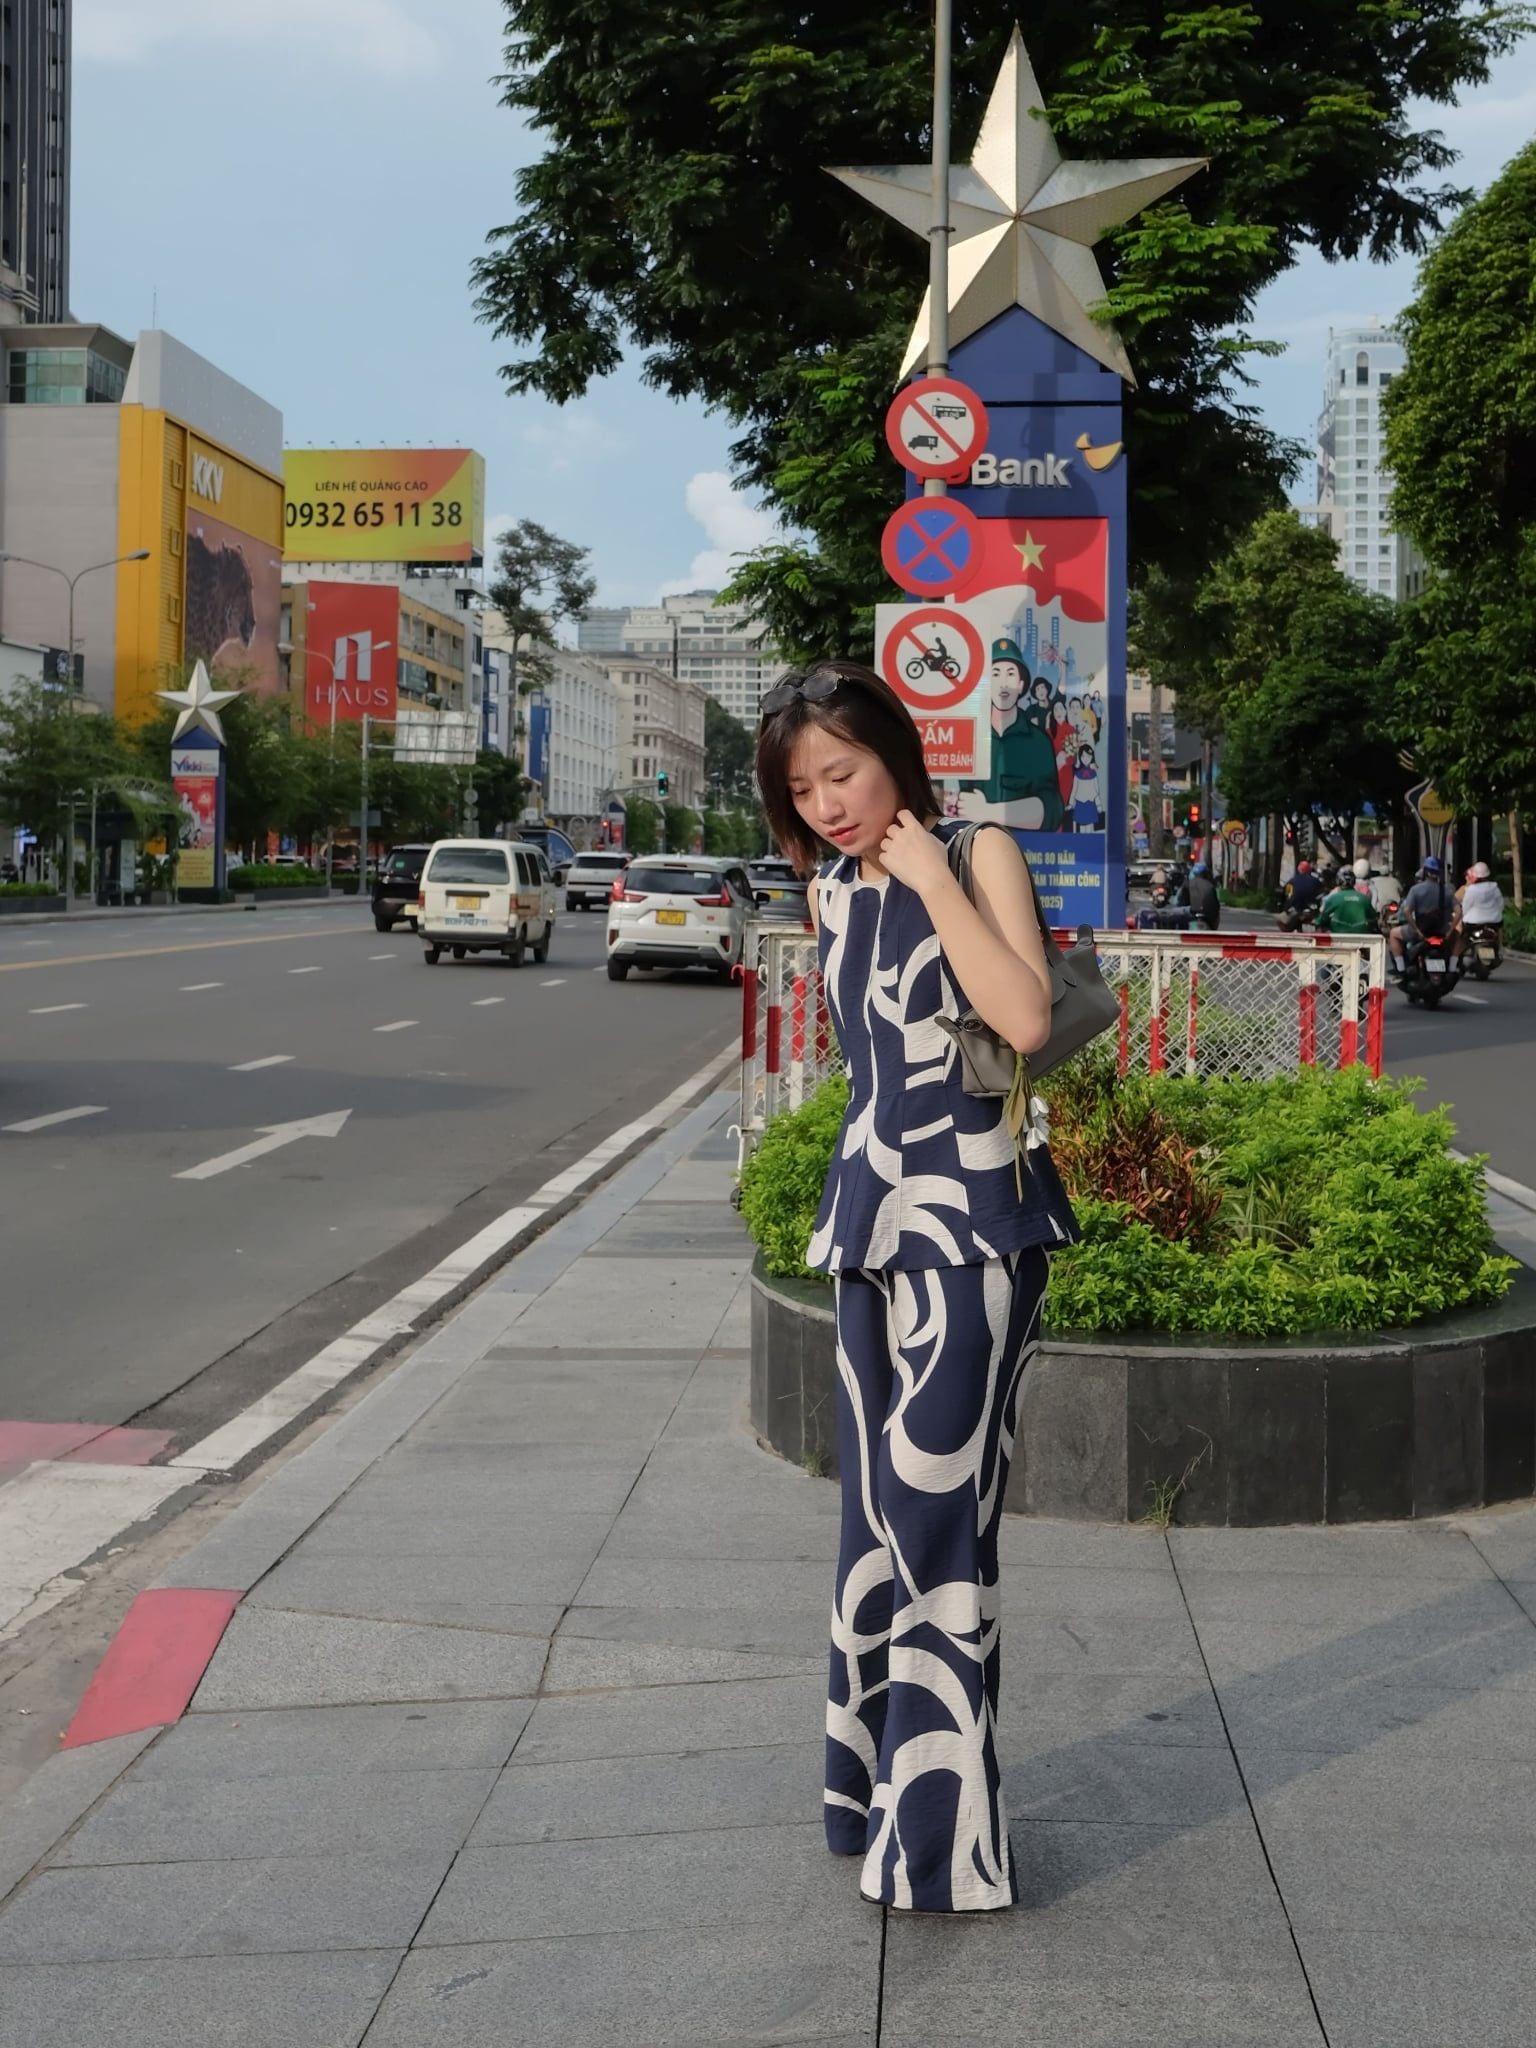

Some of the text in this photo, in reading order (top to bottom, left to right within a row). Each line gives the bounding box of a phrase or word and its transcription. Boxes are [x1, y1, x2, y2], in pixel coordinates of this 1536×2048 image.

[192, 452, 224, 504] KKV
[315, 479, 429, 493] LIÊN HỆ QUẢNG CÁO
[286, 501, 463, 528] 0932 65 11 38
[917, 719, 954, 745] ẤM
[927, 753, 938, 767] XE
[939, 753, 949, 767] 02
[1023, 848, 1043, 865] ỪNG
[1032, 870, 1101, 887] ÁM THÀNH CÔNG
